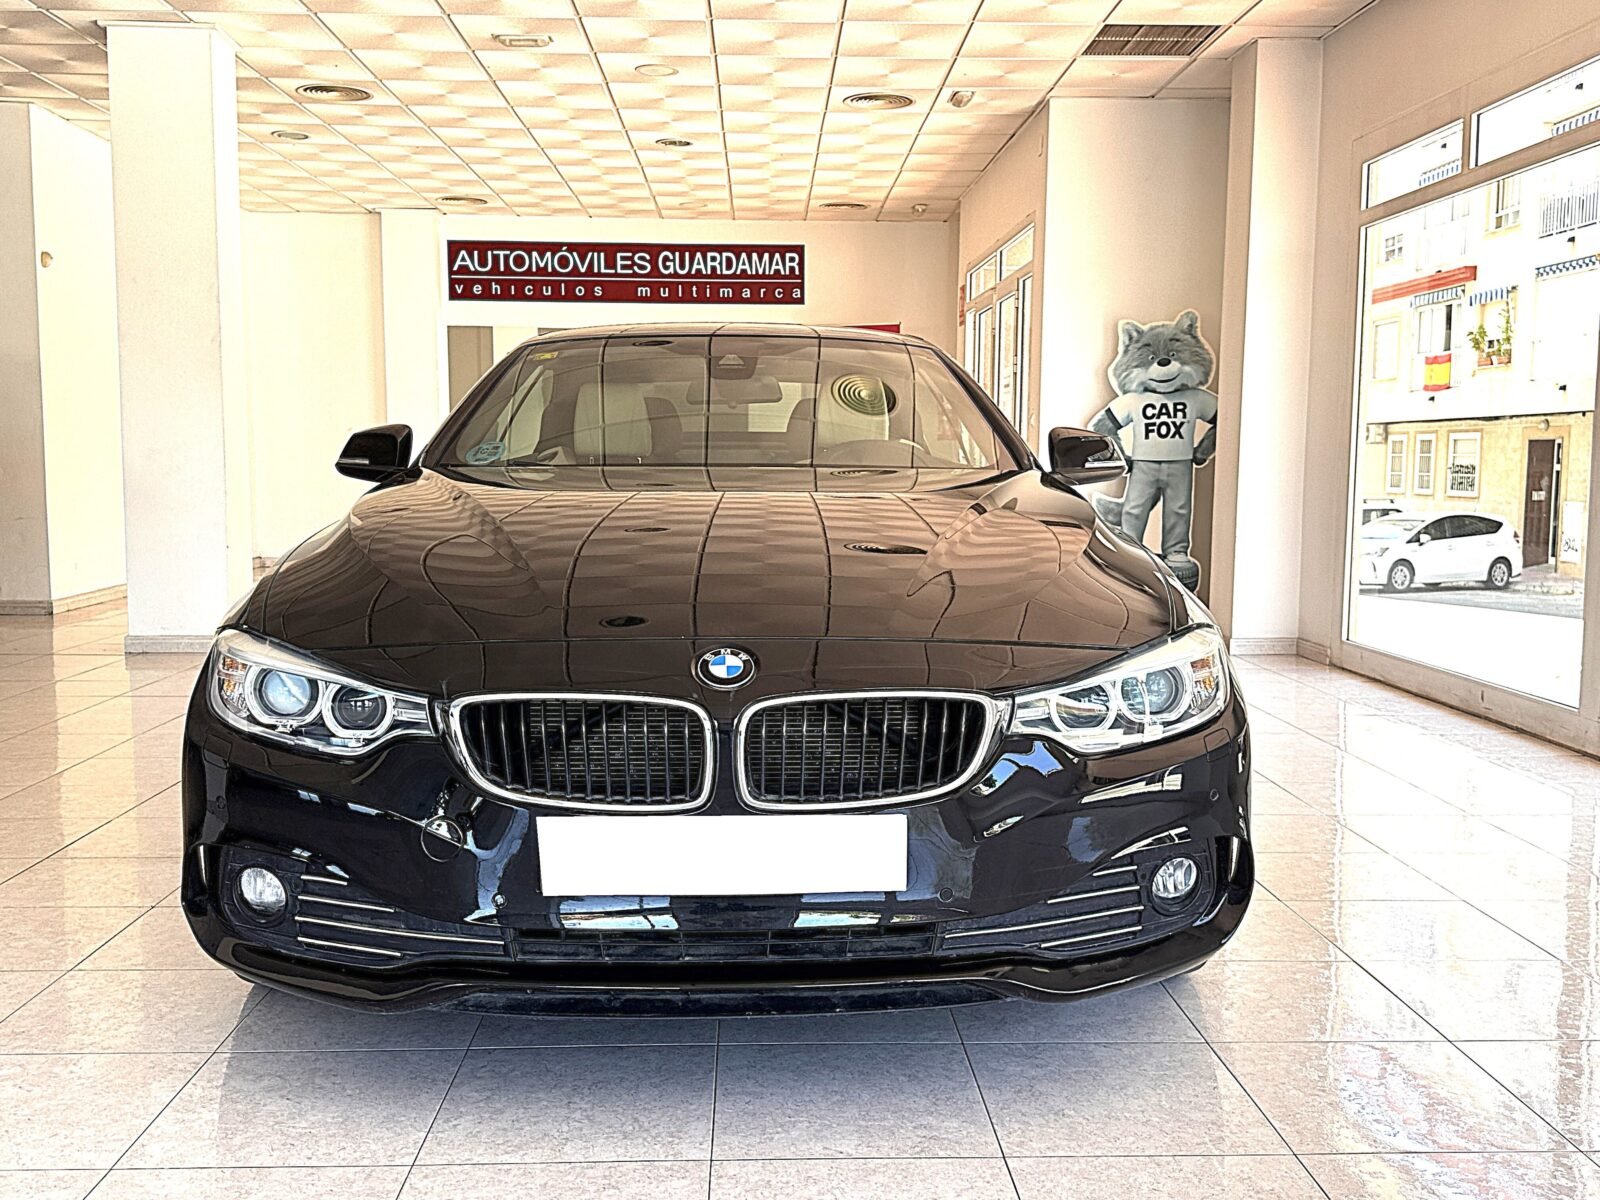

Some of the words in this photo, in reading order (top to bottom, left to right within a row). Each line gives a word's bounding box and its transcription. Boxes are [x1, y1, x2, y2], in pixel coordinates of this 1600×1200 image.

[452, 247, 651, 273] AUTOMÓVILES
[658, 251, 801, 275] GUARDAMAR
[637, 283, 802, 299] multimarca
[1142, 402, 1187, 420] CAR
[1144, 421, 1185, 440] FOX
[704, 648, 750, 661] BMW
